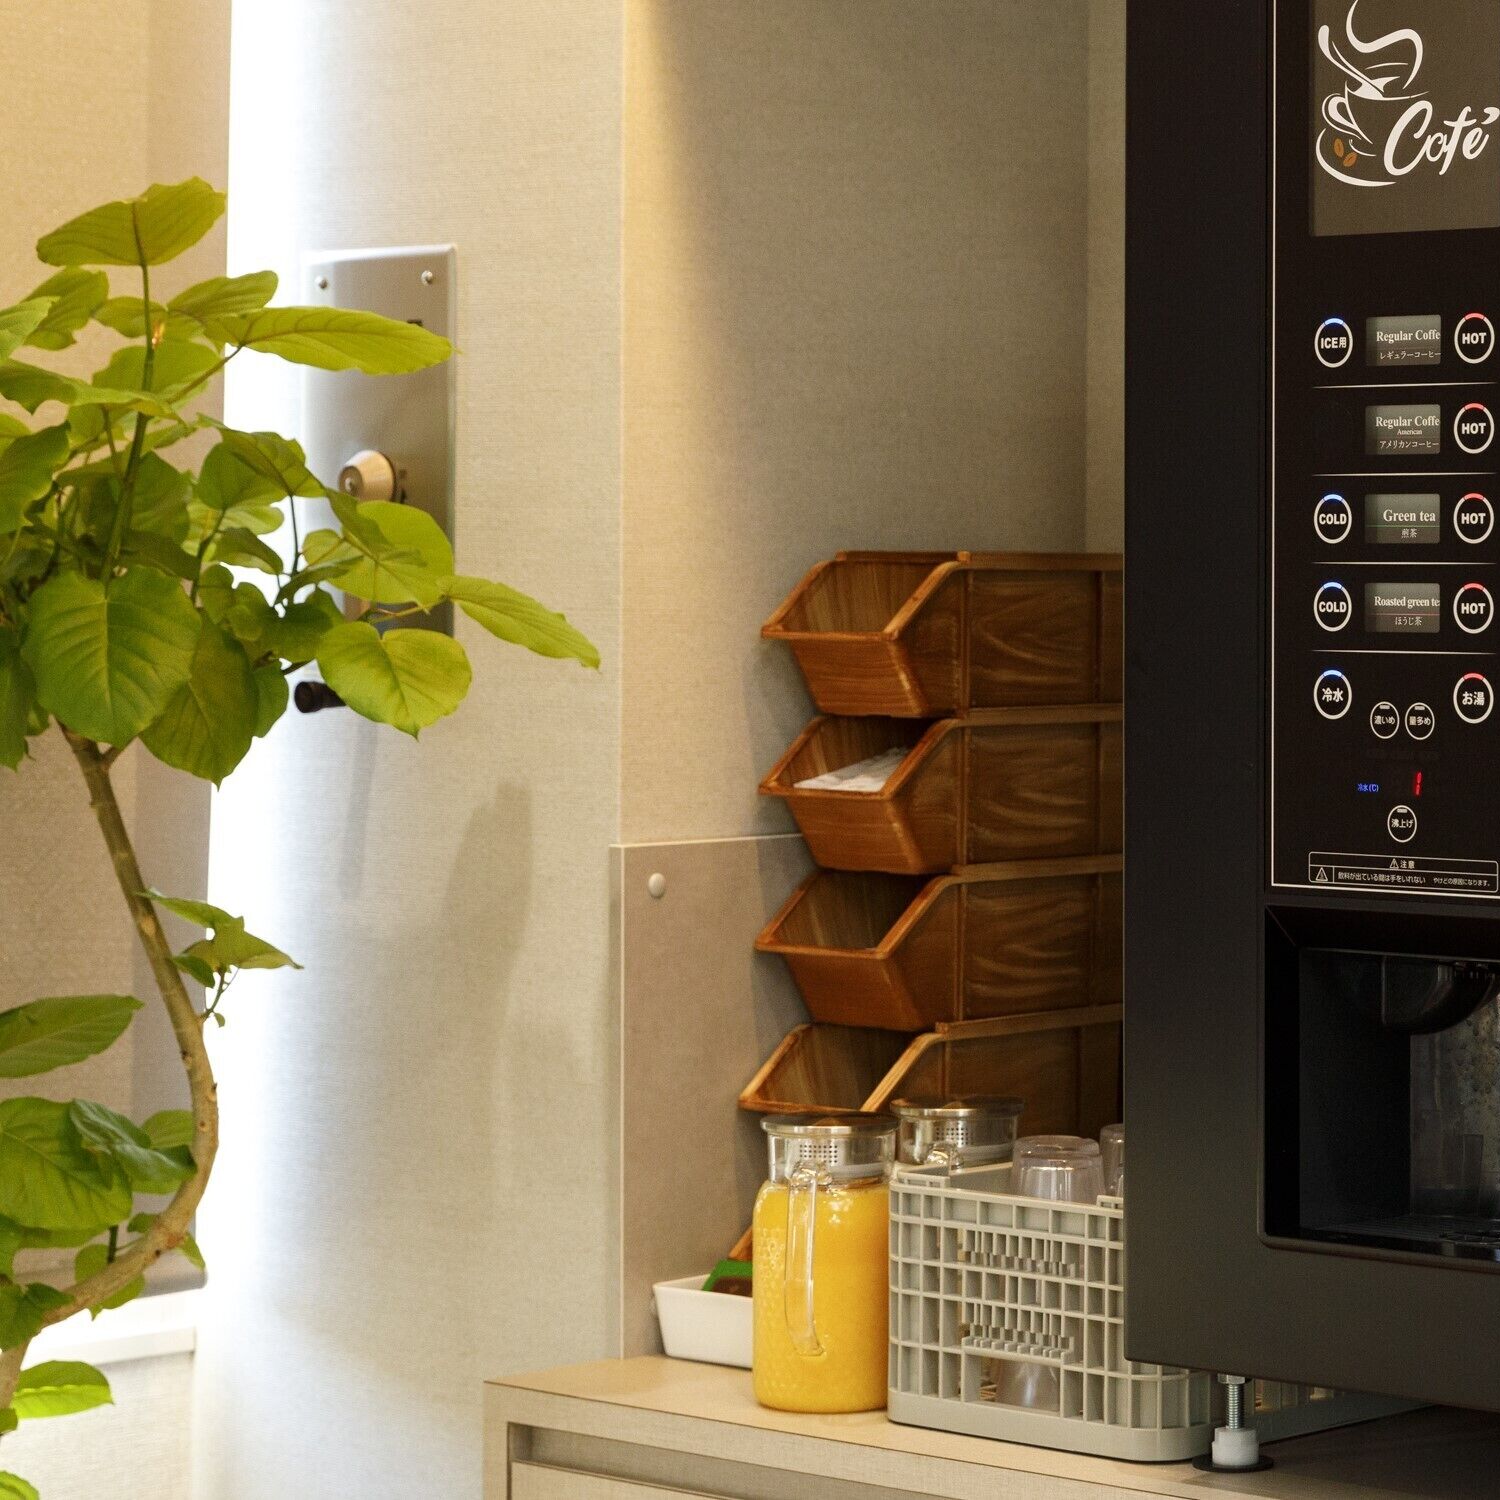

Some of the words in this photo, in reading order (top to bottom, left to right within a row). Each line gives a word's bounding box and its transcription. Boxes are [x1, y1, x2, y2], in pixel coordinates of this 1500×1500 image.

[1320, 336, 1347, 349] ICE用
[1376, 330, 1414, 344] Regular
[1462, 332, 1487, 345] HOT
[1380, 351, 1441, 360] レギュラーコーヒー
[1375, 416, 1413, 429] Regular
[1461, 422, 1487, 435] HOT
[1380, 440, 1440, 449] アメリカンコーヒー
[1319, 513, 1347, 525] COLD
[1383, 509, 1417, 522] Green
[1419, 510, 1436, 522] tea
[1461, 513, 1486, 525] HOT
[1401, 528, 1418, 538] 煎茶
[1318, 601, 1347, 613] COLD
[1374, 596, 1406, 607] Roasted
[1407, 598, 1430, 608] green
[1461, 602, 1486, 615] HOT
[1395, 616, 1423, 626] ほうじ茶
[1321, 687, 1344, 703] 冷水
[1462, 691, 1485, 706] お湯
[1374, 715, 1396, 725] 濃いめ
[1409, 716, 1431, 726] 量多め
[1391, 818, 1414, 829] 沸上げ
[1400, 860, 1415, 869] 注意
